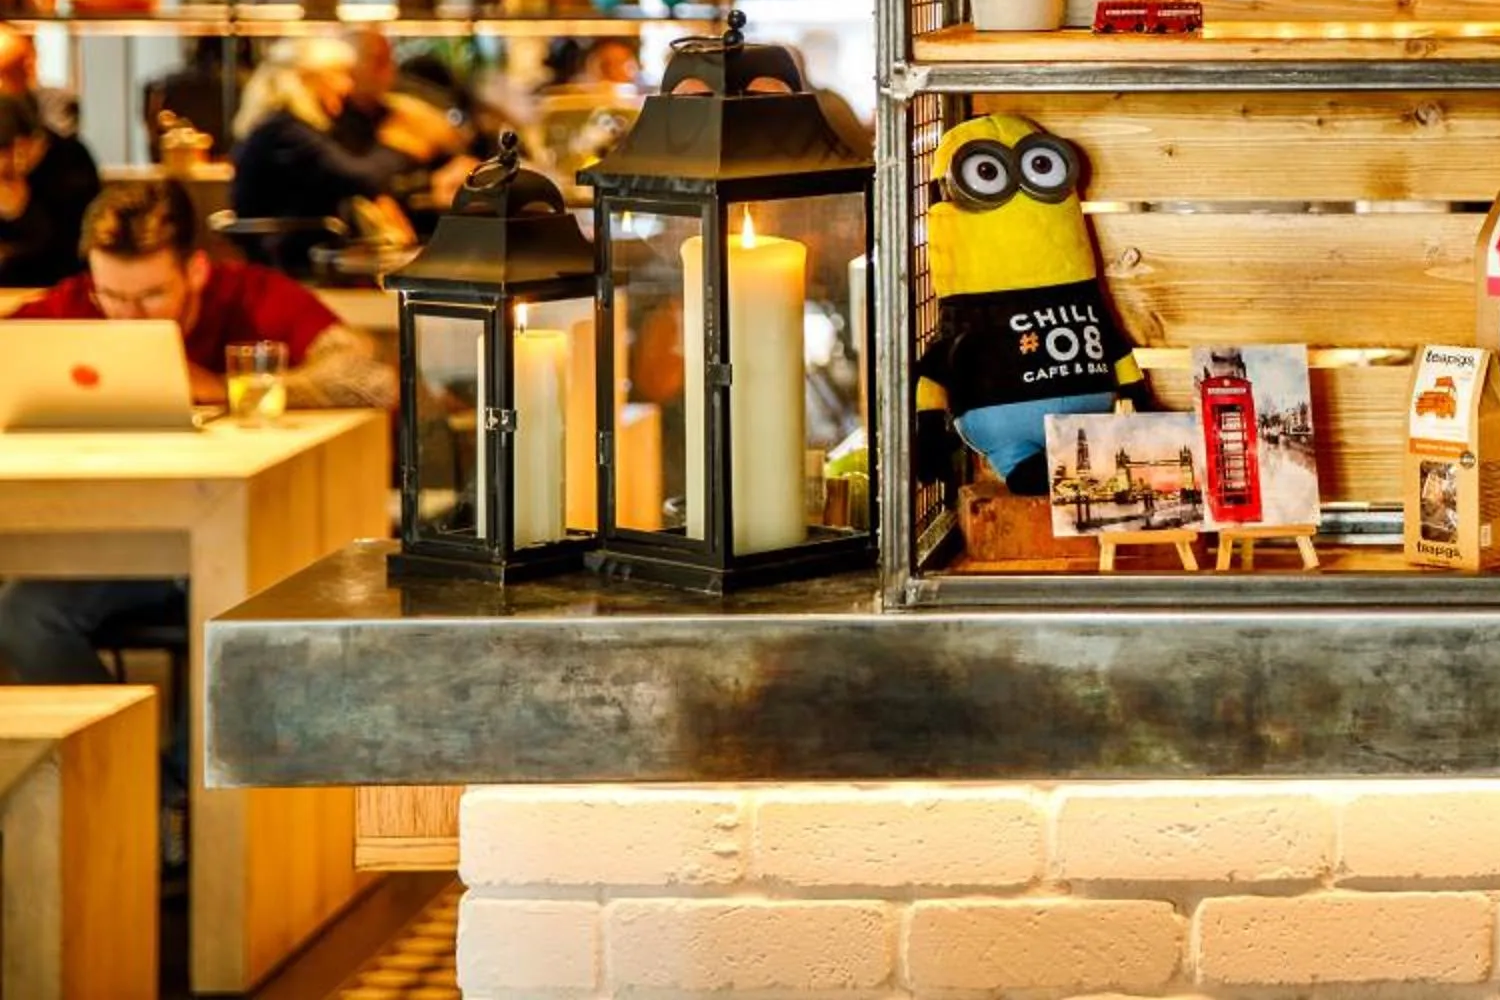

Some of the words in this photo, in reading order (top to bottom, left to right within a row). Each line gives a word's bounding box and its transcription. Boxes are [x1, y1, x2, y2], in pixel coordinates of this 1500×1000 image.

[1008, 303, 1100, 333] CHILL
[1019, 324, 1105, 362] #08
[1023, 364, 1071, 383] CAFE
